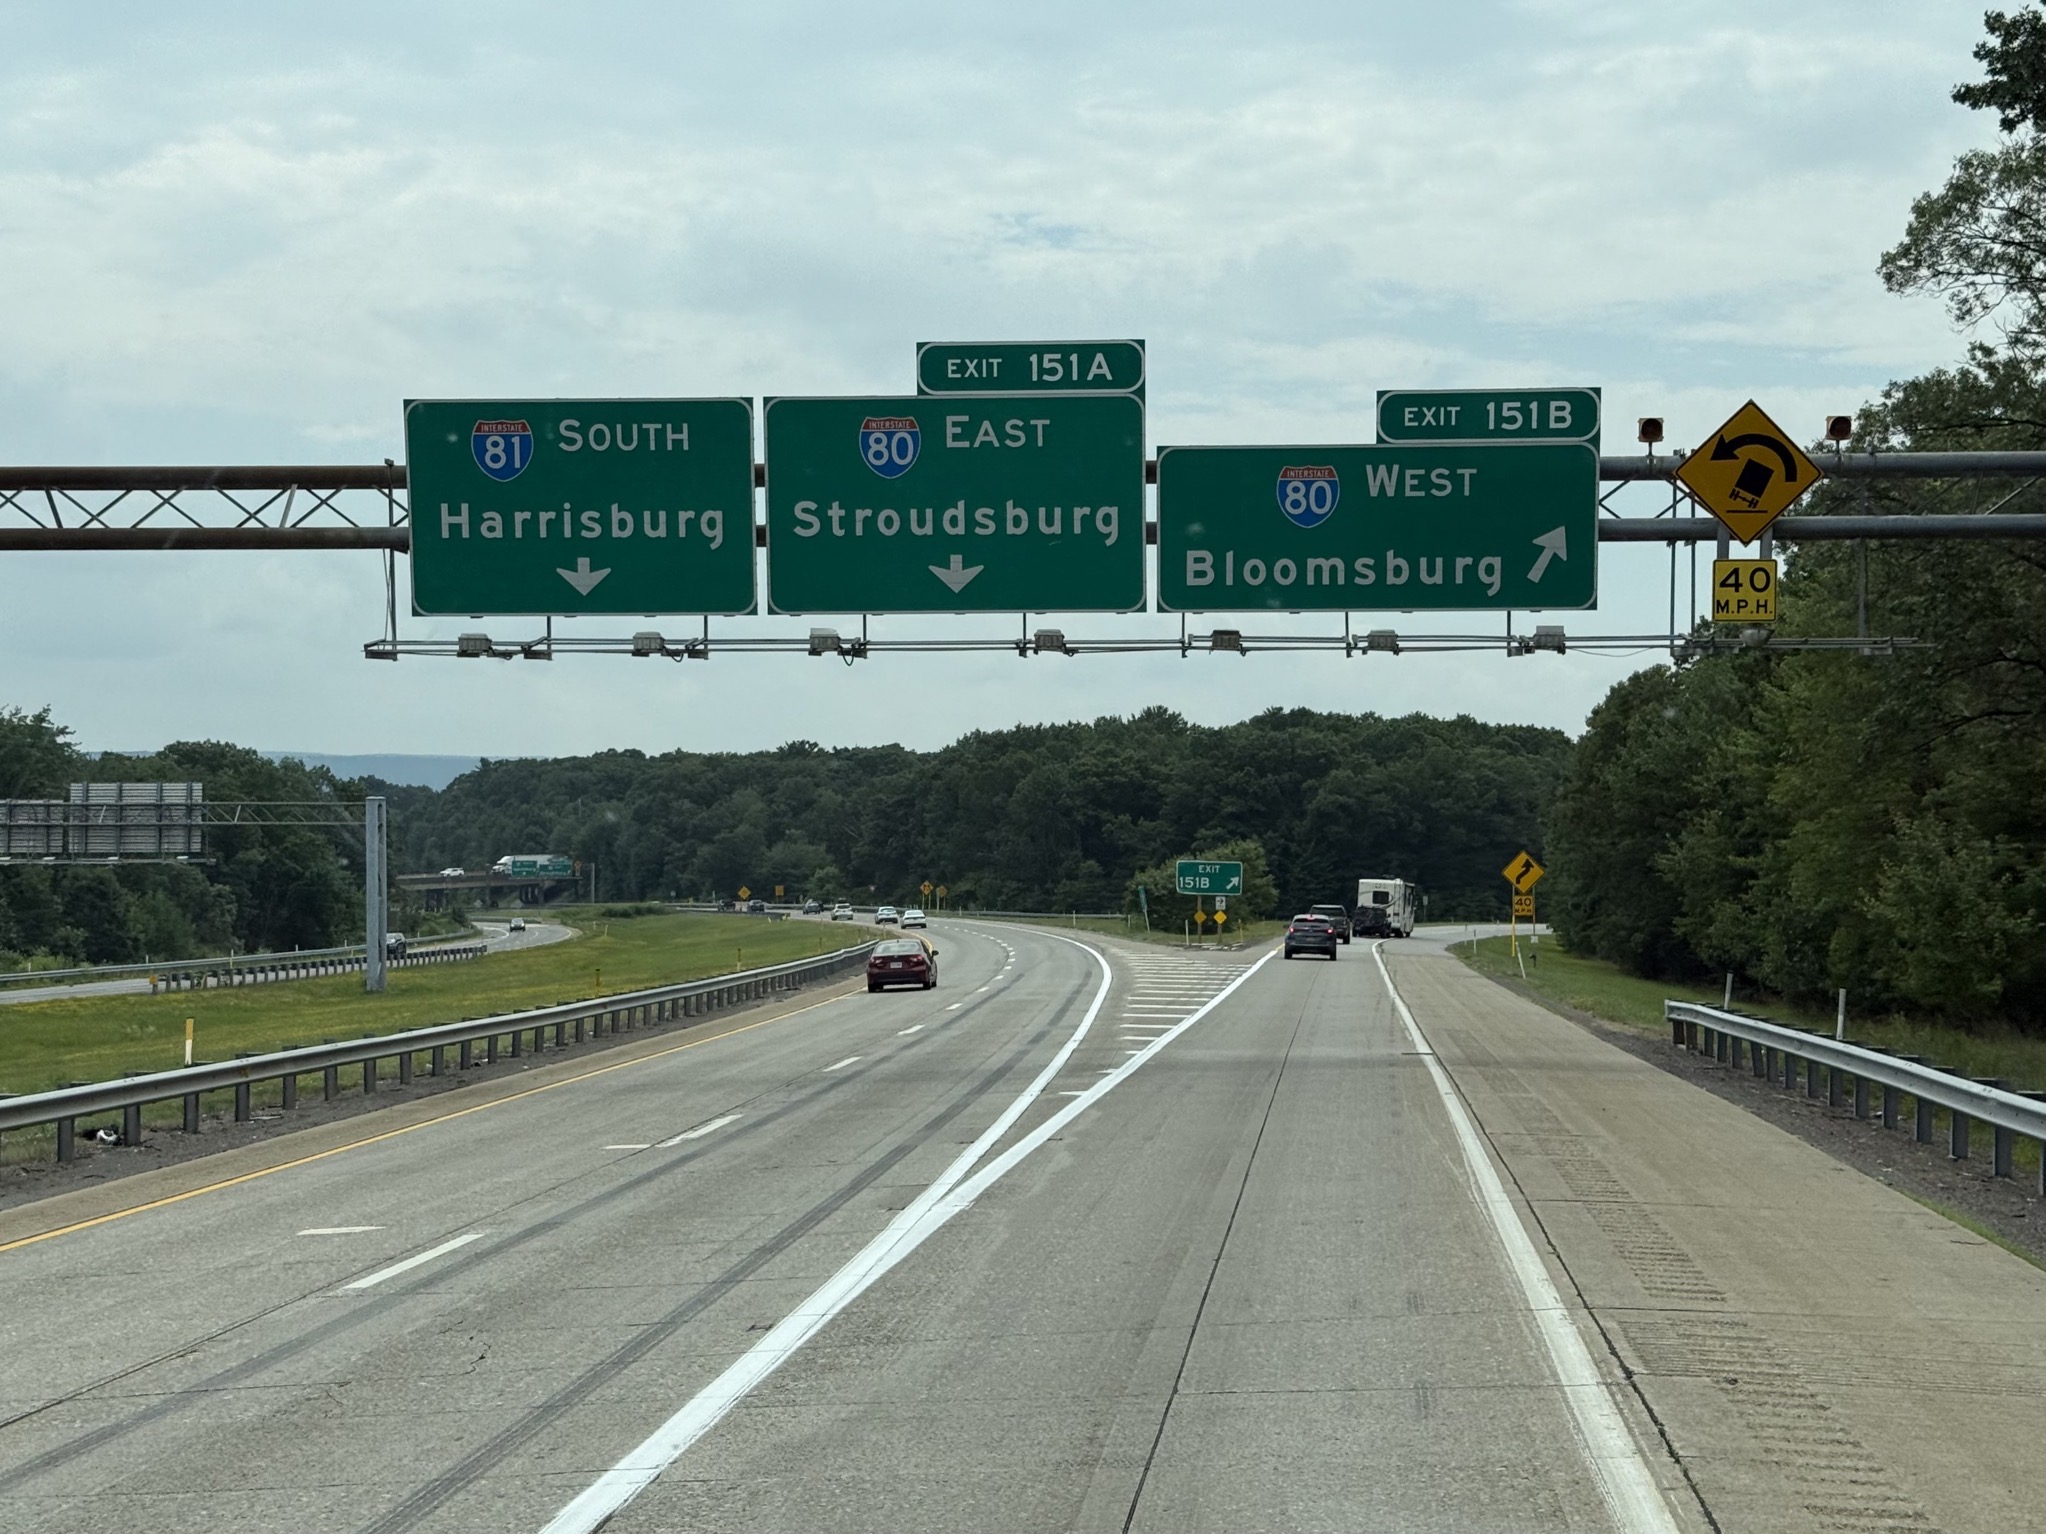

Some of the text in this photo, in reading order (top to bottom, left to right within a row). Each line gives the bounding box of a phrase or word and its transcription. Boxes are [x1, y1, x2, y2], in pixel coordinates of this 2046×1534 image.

[946, 352, 1113, 382] EXIT 151A
[480, 423, 524, 433] INTERSTATE
[869, 420, 911, 430] INTERSTATE
[1404, 400, 1573, 430] EXIT 151B
[558, 418, 690, 452] SOUTH
[945, 415, 1051, 448] EAST
[484, 435, 521, 469] 81
[867, 431, 914, 466] 80
[1286, 469, 1330, 478] INTERSTATE
[1365, 464, 1478, 497] WEST
[1284, 480, 1333, 515] 80
[439, 502, 724, 549] Harrisburg
[793, 500, 1119, 547] Stroudsburg
[1185, 549, 1502, 596] Bloomsburg
[1719, 566, 1771, 593] 40
[1716, 598, 1773, 615] M.P.H.
[1179, 876, 1210, 889] 151B
[1198, 864, 1220, 873] EXIT
[1514, 897, 1532, 906] 40
